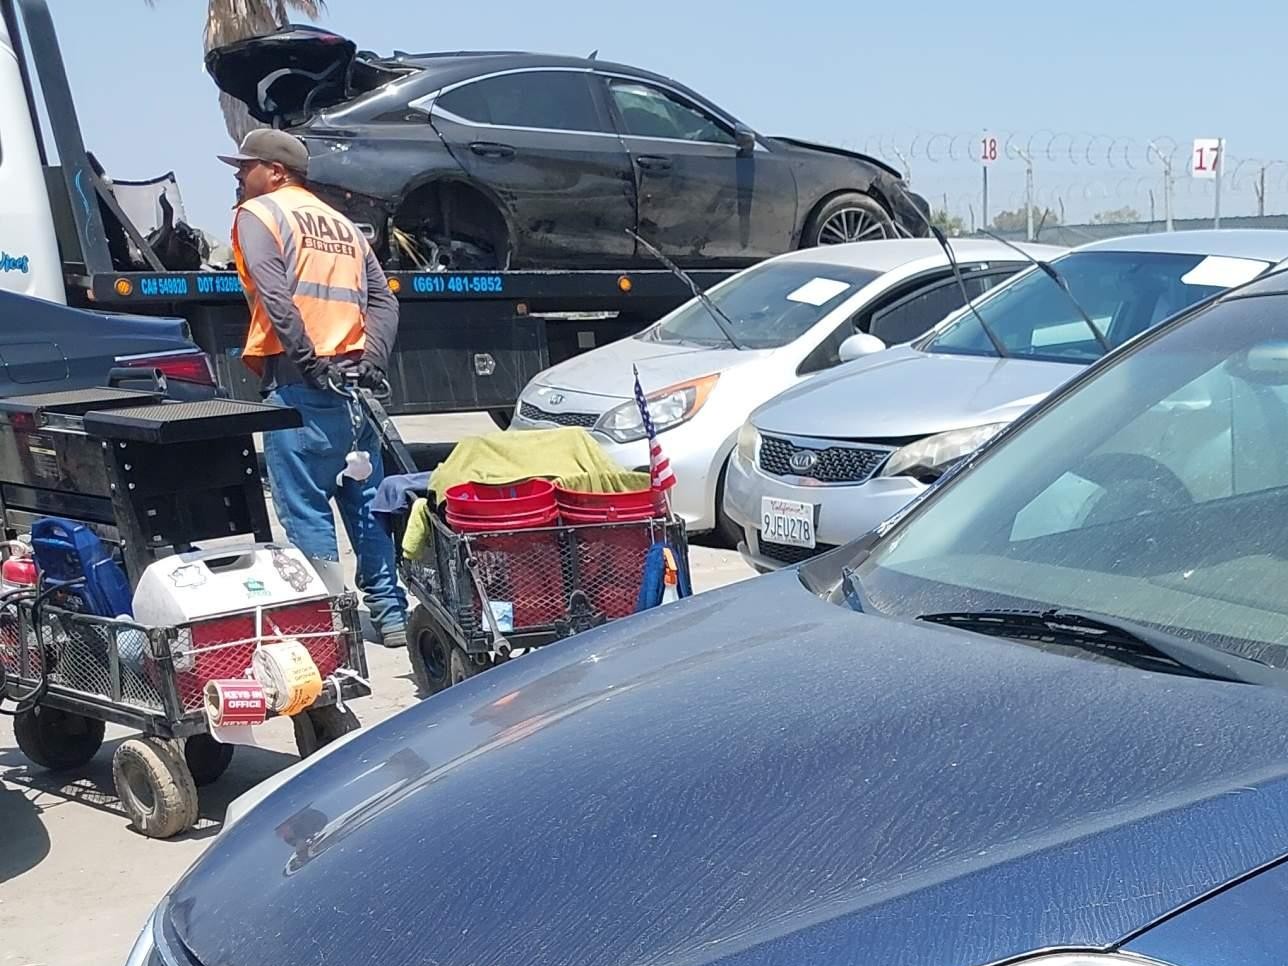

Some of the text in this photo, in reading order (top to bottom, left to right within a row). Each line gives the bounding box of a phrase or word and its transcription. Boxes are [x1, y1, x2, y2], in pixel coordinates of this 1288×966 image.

[981, 138, 997, 160] 18
[1195, 147, 1223, 170] 17
[291, 210, 354, 243] MAD
[197, 276, 214, 292] DOT
[413, 276, 502, 292] (661) 481-5852
[764, 514, 810, 541] 9JEU278
[223, 690, 263, 699] KEYS IN
[228, 700, 262, 709] OFFICE
